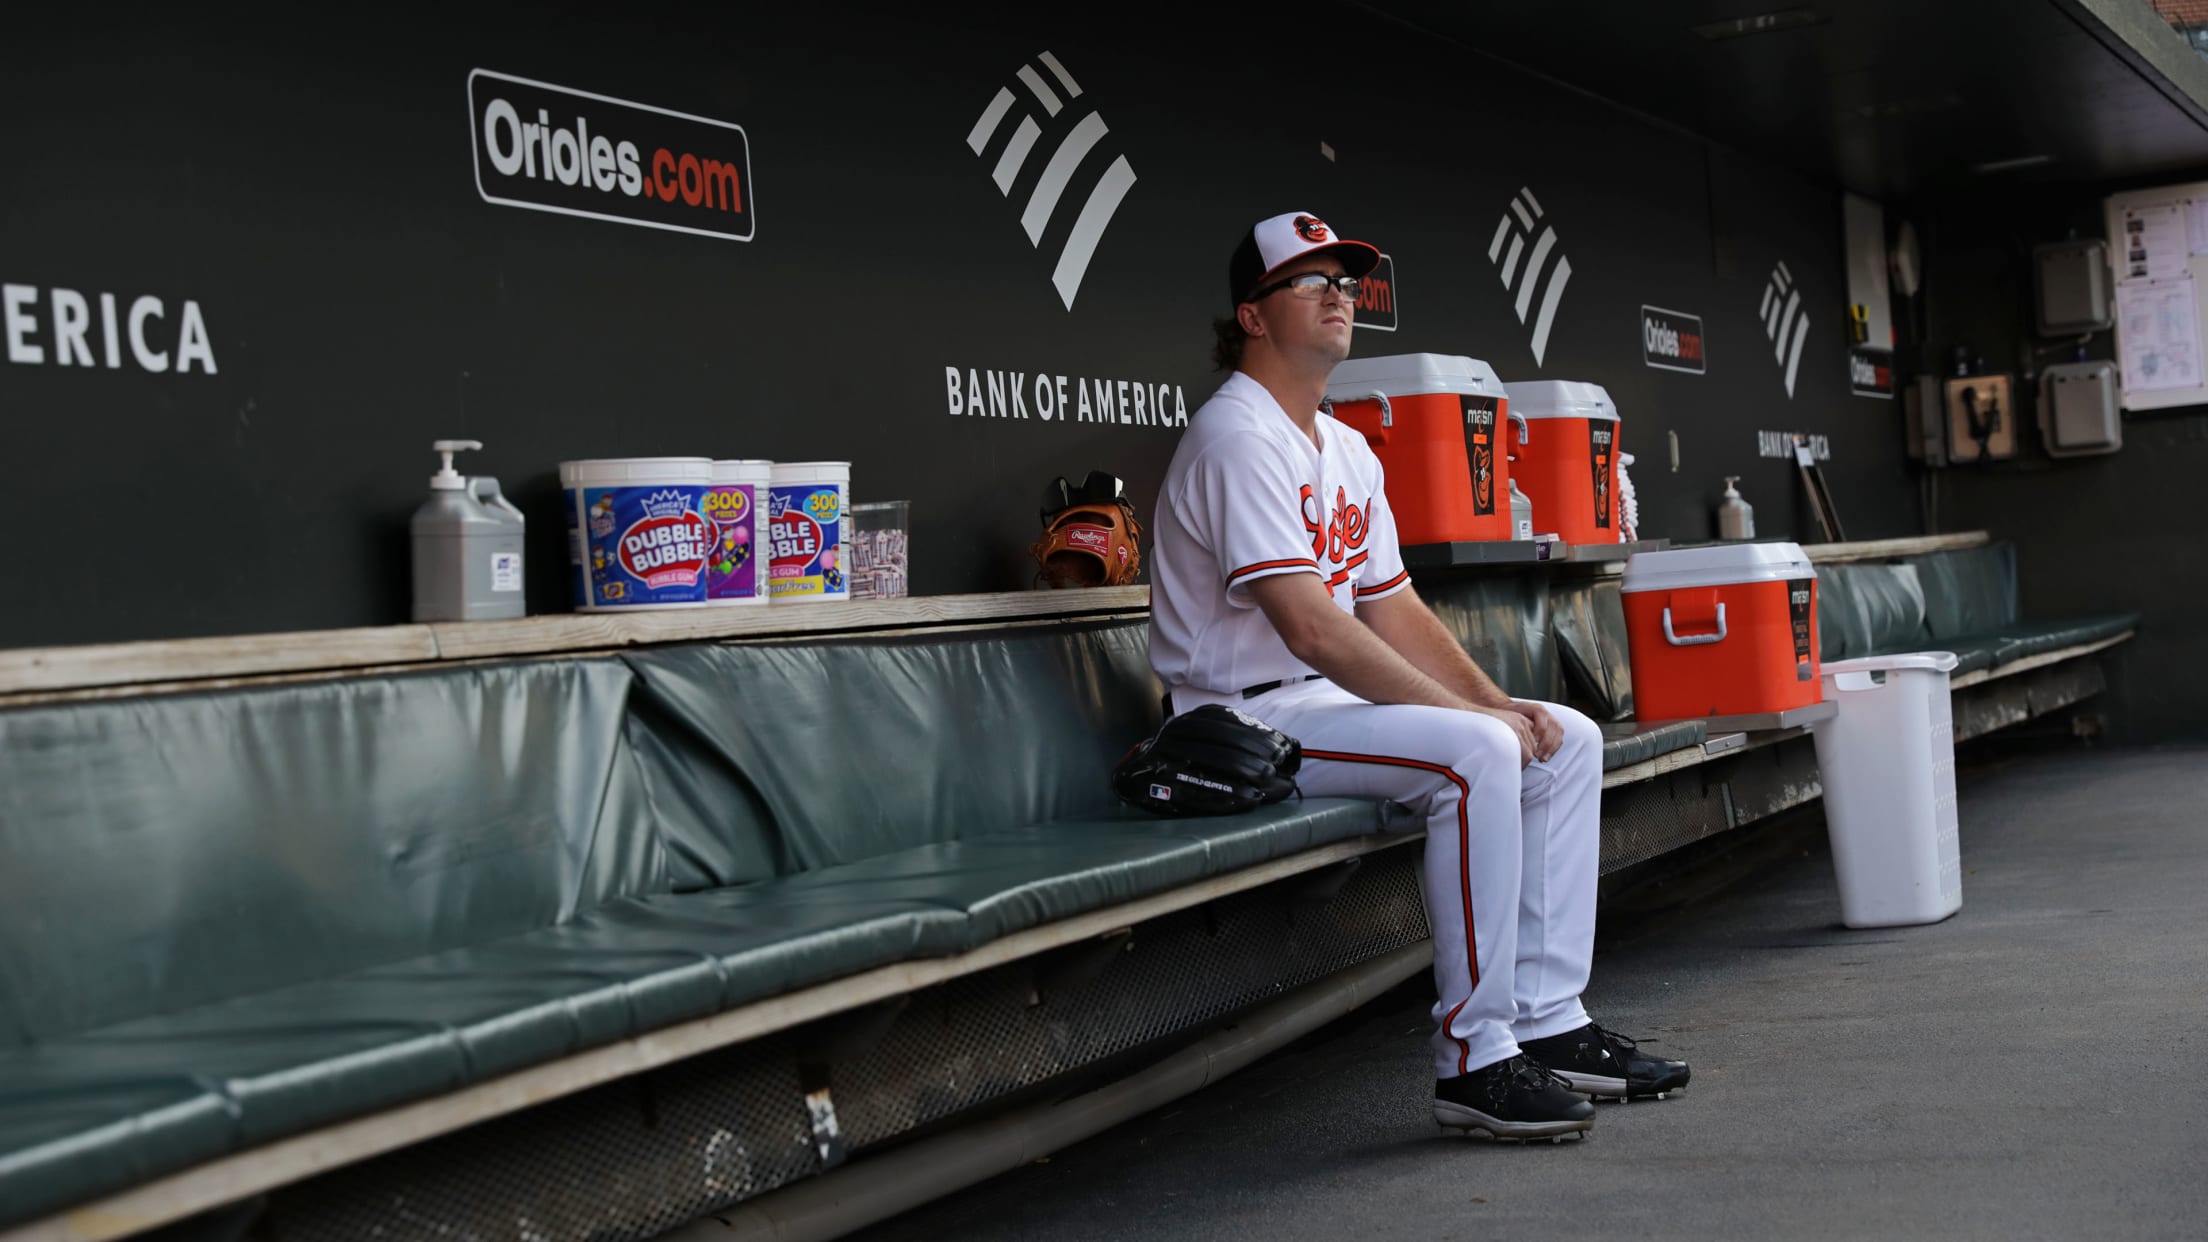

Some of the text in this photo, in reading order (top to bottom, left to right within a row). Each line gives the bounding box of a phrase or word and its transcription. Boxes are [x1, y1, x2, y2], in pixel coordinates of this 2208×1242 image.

[484, 98, 742, 214] Orioles.com
[946, 366, 1188, 427] BANK OF AMERICA
[707, 491, 744, 511] 300
[809, 494, 839, 512] 300
[625, 524, 703, 554] DUBBLE
[769, 521, 811, 541] BLE
[632, 541, 705, 573] BUBBLE
